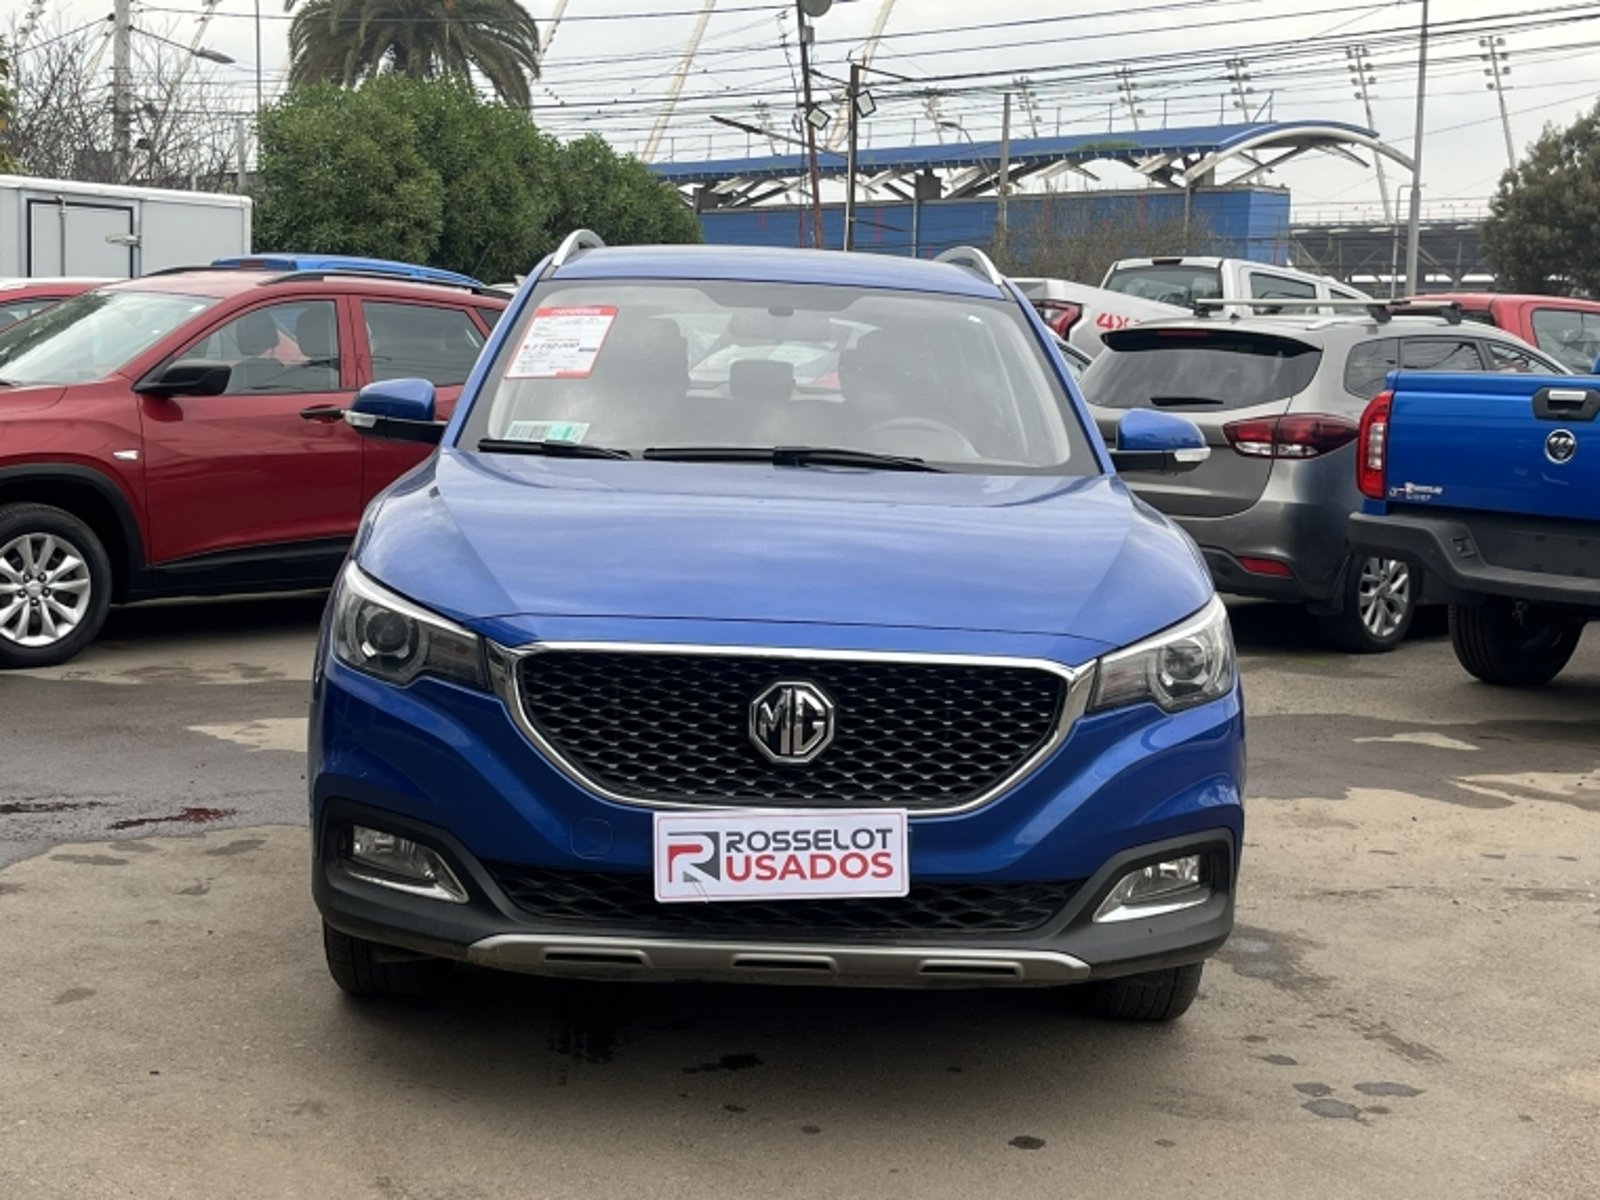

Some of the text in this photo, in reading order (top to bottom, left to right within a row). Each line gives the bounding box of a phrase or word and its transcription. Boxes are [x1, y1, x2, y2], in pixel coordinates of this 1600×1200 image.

[758, 686, 827, 756] MG
[725, 828, 894, 853] ROSSELOT
[725, 851, 894, 882] USADOS
